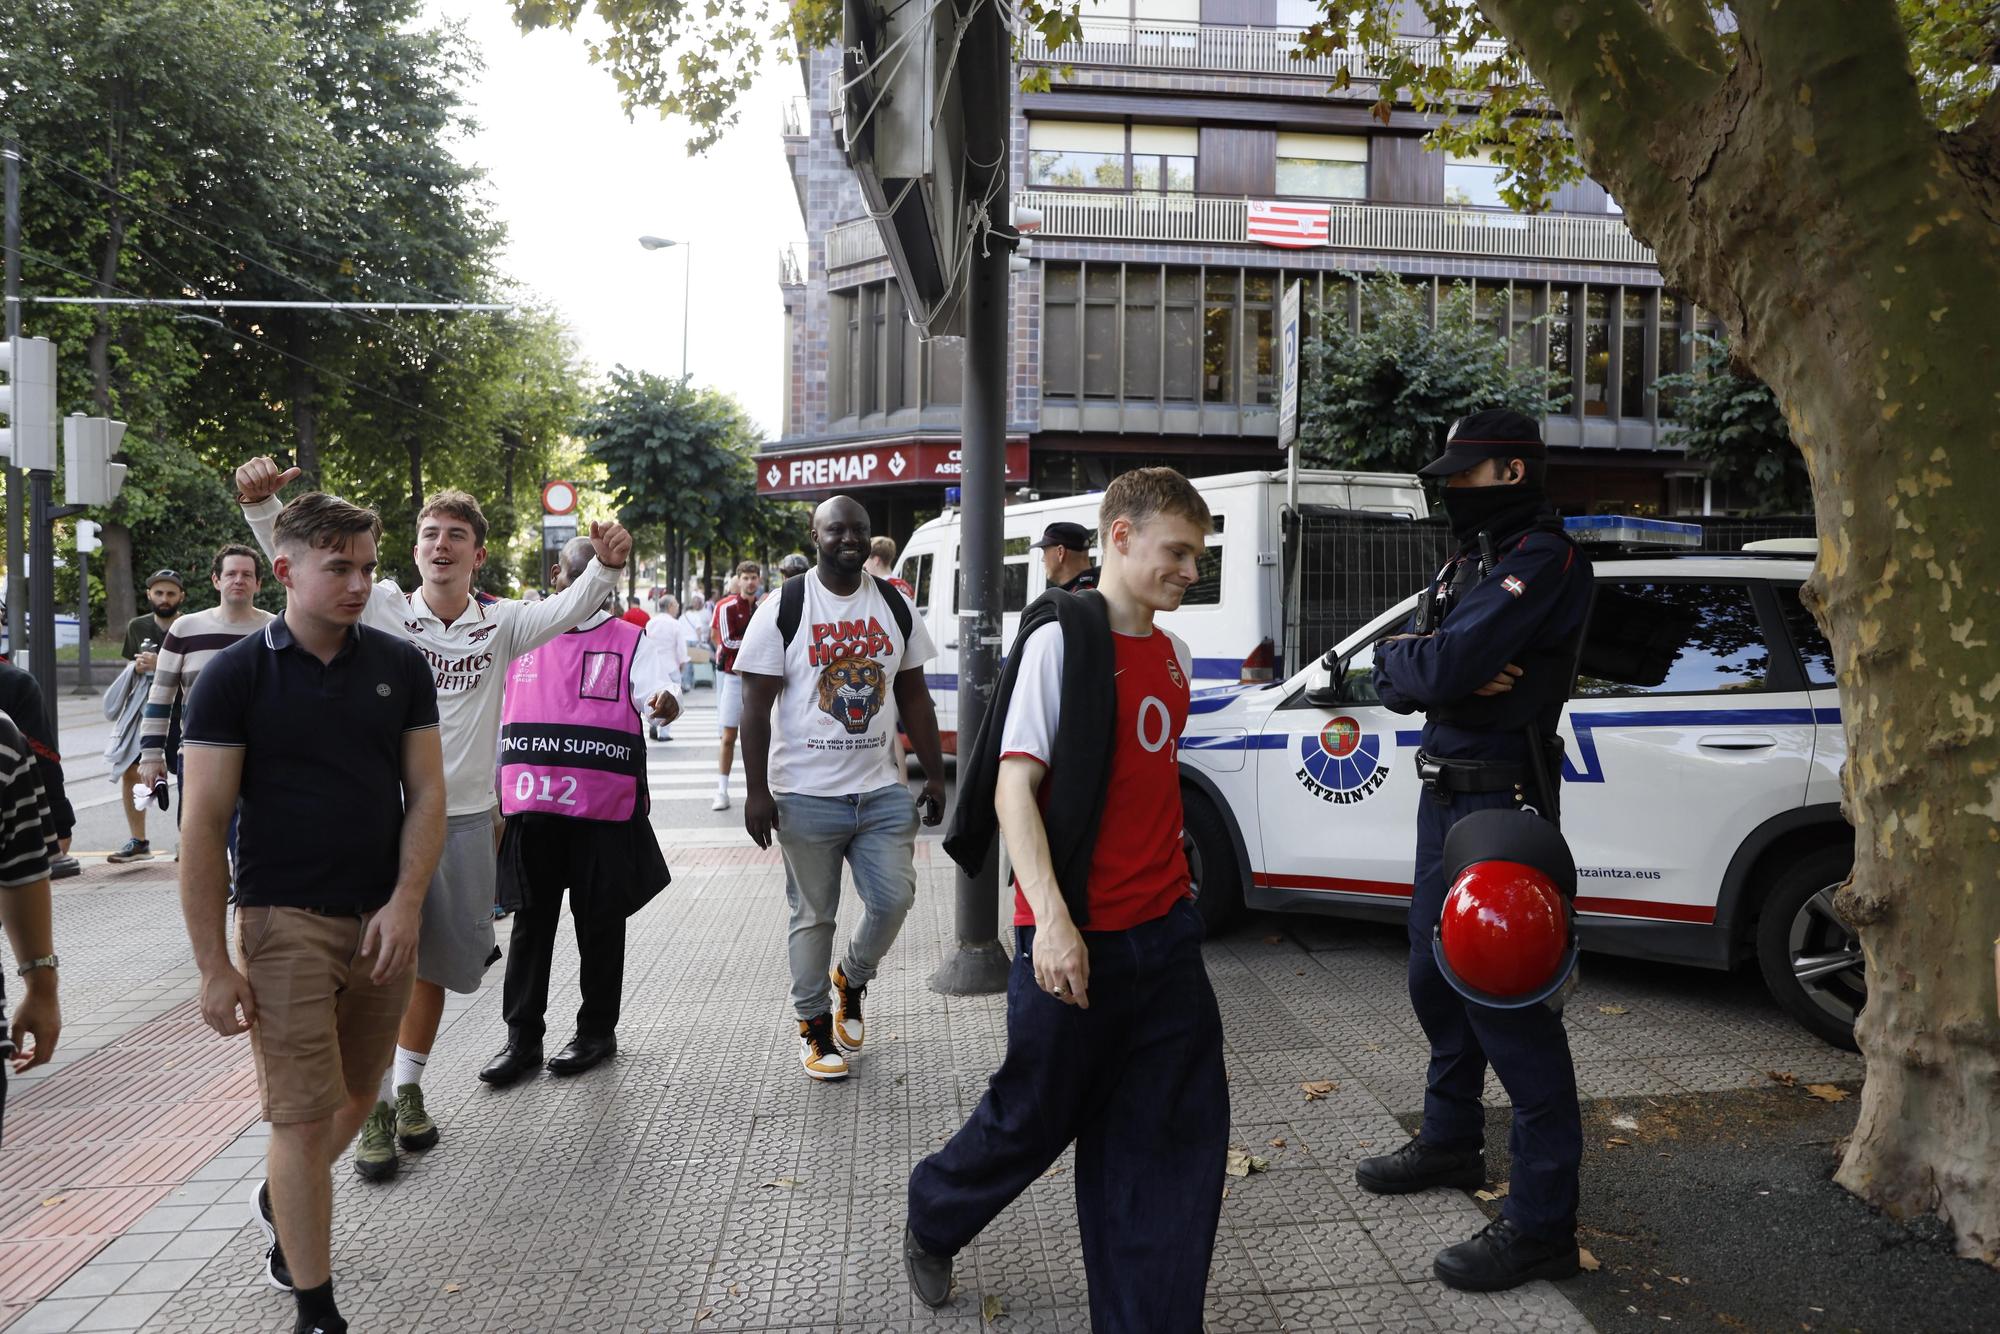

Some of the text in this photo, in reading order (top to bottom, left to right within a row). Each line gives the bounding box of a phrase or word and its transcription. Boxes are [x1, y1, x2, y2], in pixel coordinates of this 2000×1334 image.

[789, 453, 878, 486] FREMAP
[812, 616, 888, 644] PUMA
[409, 640, 493, 673] mirates
[808, 634, 894, 667] HOOPS
[436, 672, 481, 691] BETTER
[500, 736, 631, 761] TING FAN SUPPORT
[515, 771, 578, 806] 012
[1296, 765, 1390, 805] ERTZAINTZA
